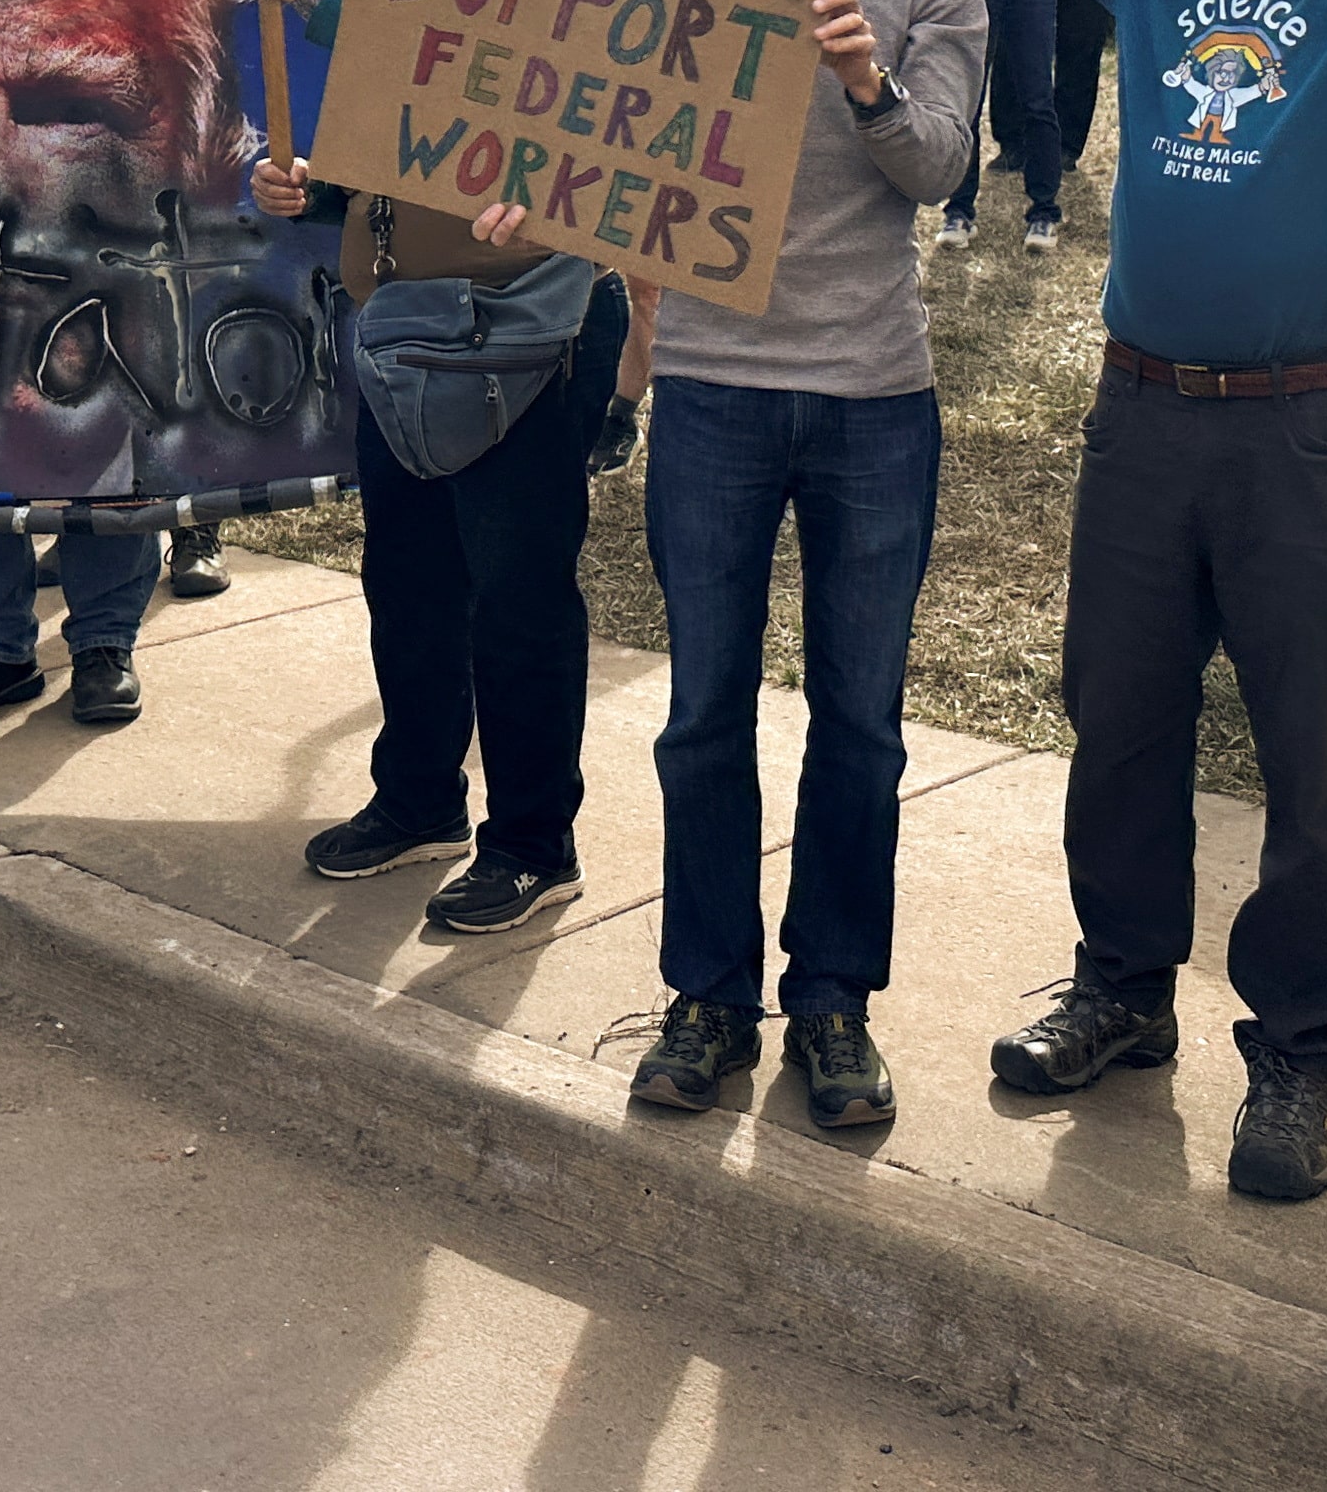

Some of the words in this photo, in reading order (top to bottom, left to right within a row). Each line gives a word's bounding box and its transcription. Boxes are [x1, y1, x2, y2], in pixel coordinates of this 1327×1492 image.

[412, 24, 745, 188] FEDERAL
[1163, 160, 1191, 177] BUT
[397, 102, 754, 282] WORKERS
